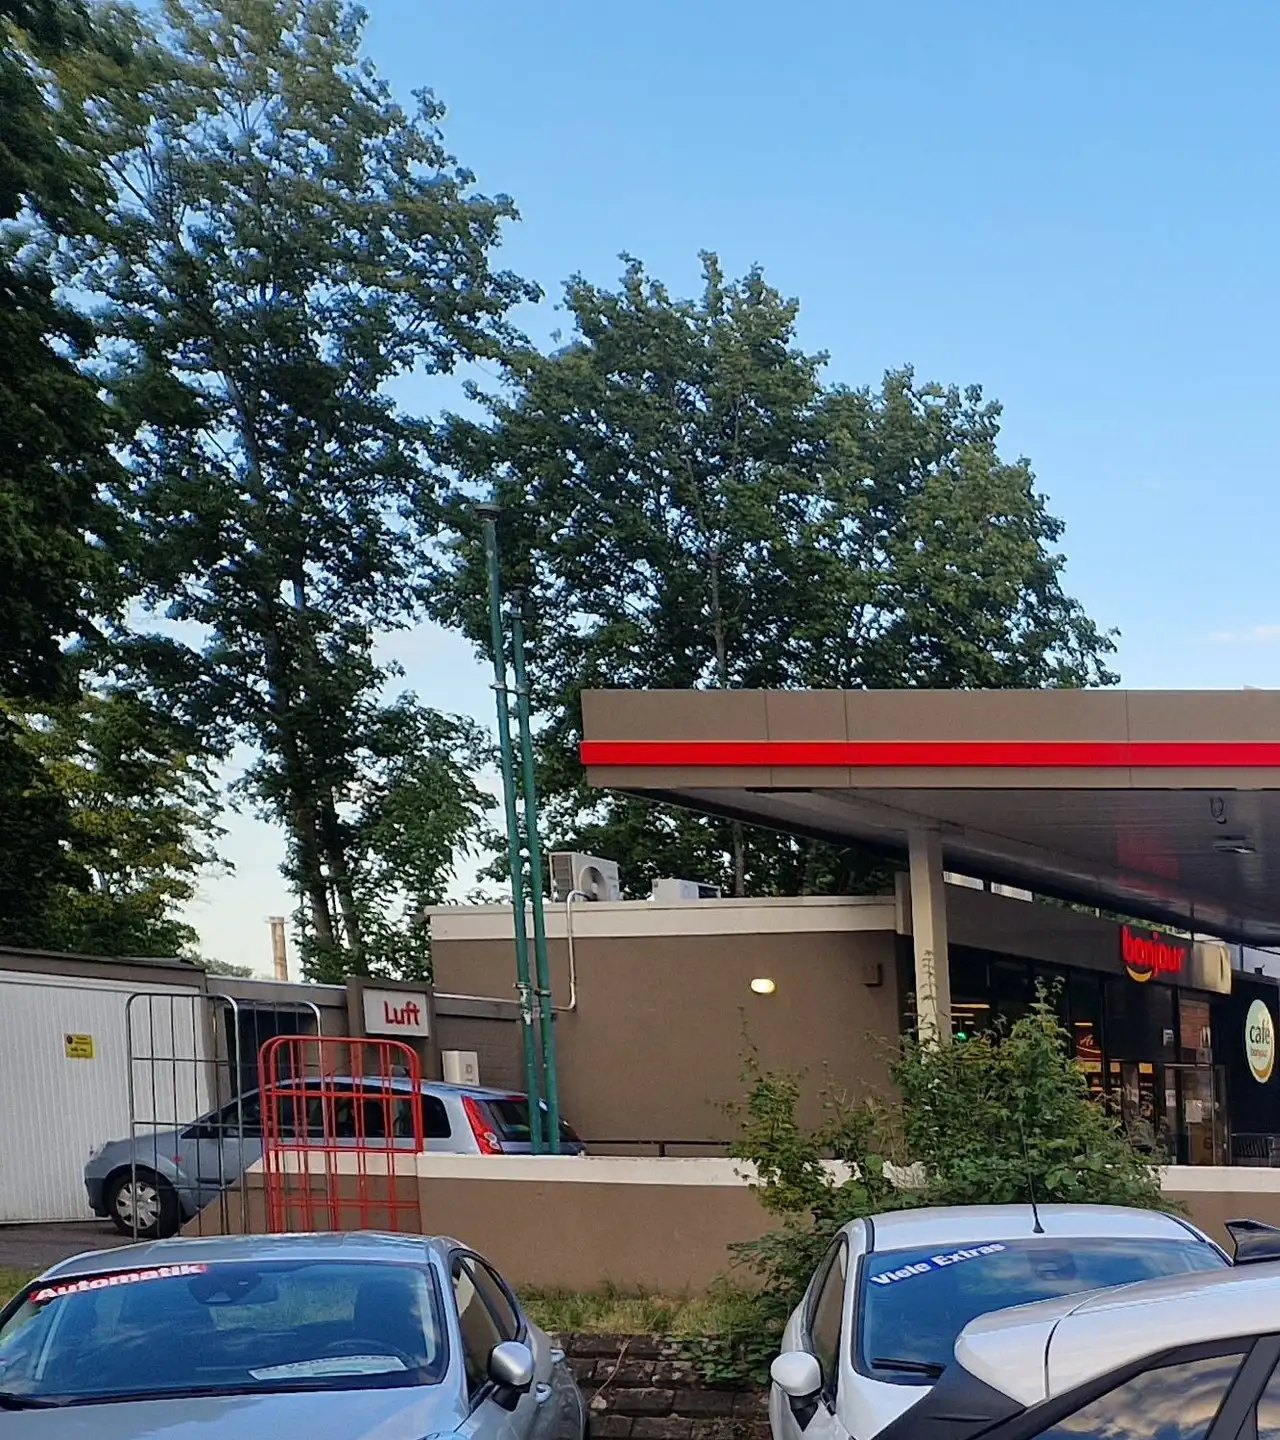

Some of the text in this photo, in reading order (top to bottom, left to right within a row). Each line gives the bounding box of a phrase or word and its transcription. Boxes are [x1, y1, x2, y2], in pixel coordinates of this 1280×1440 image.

[383, 1000, 420, 1026] Luft
[33, 1264, 204, 1301] Automatik
[870, 1243, 1006, 1285] Viele Extras
